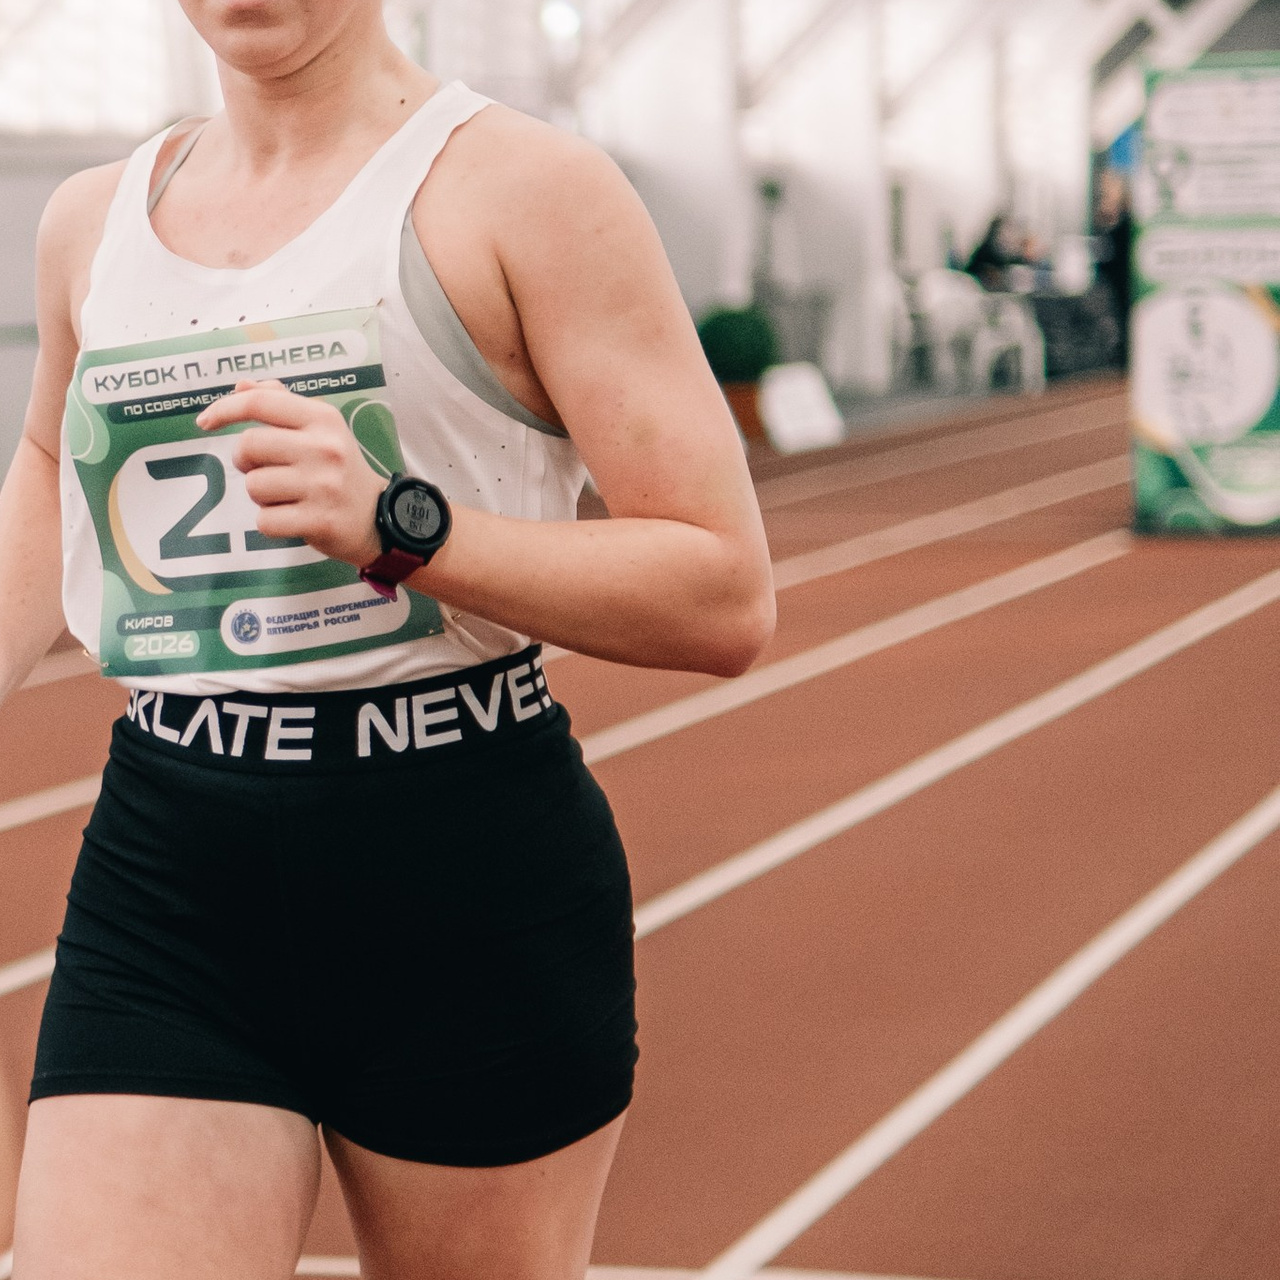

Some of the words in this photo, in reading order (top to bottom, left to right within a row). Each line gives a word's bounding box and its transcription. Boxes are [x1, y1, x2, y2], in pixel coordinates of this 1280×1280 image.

[94, 365, 177, 393] КУБОК
[184, 362, 209, 380] П.
[216, 340, 348, 375] ЛЕДНЕВА
[123, 404, 143, 416] ПО
[145, 453, 308, 560] 2
[124, 614, 174, 631] КИРОВ
[266, 609, 320, 625] ФЕДЕРАЦИЯ
[267, 621, 320, 636] ПЯТИБОРЬЯ
[324, 613, 361, 627] РОССИИ
[132, 634, 195, 657] 2026
